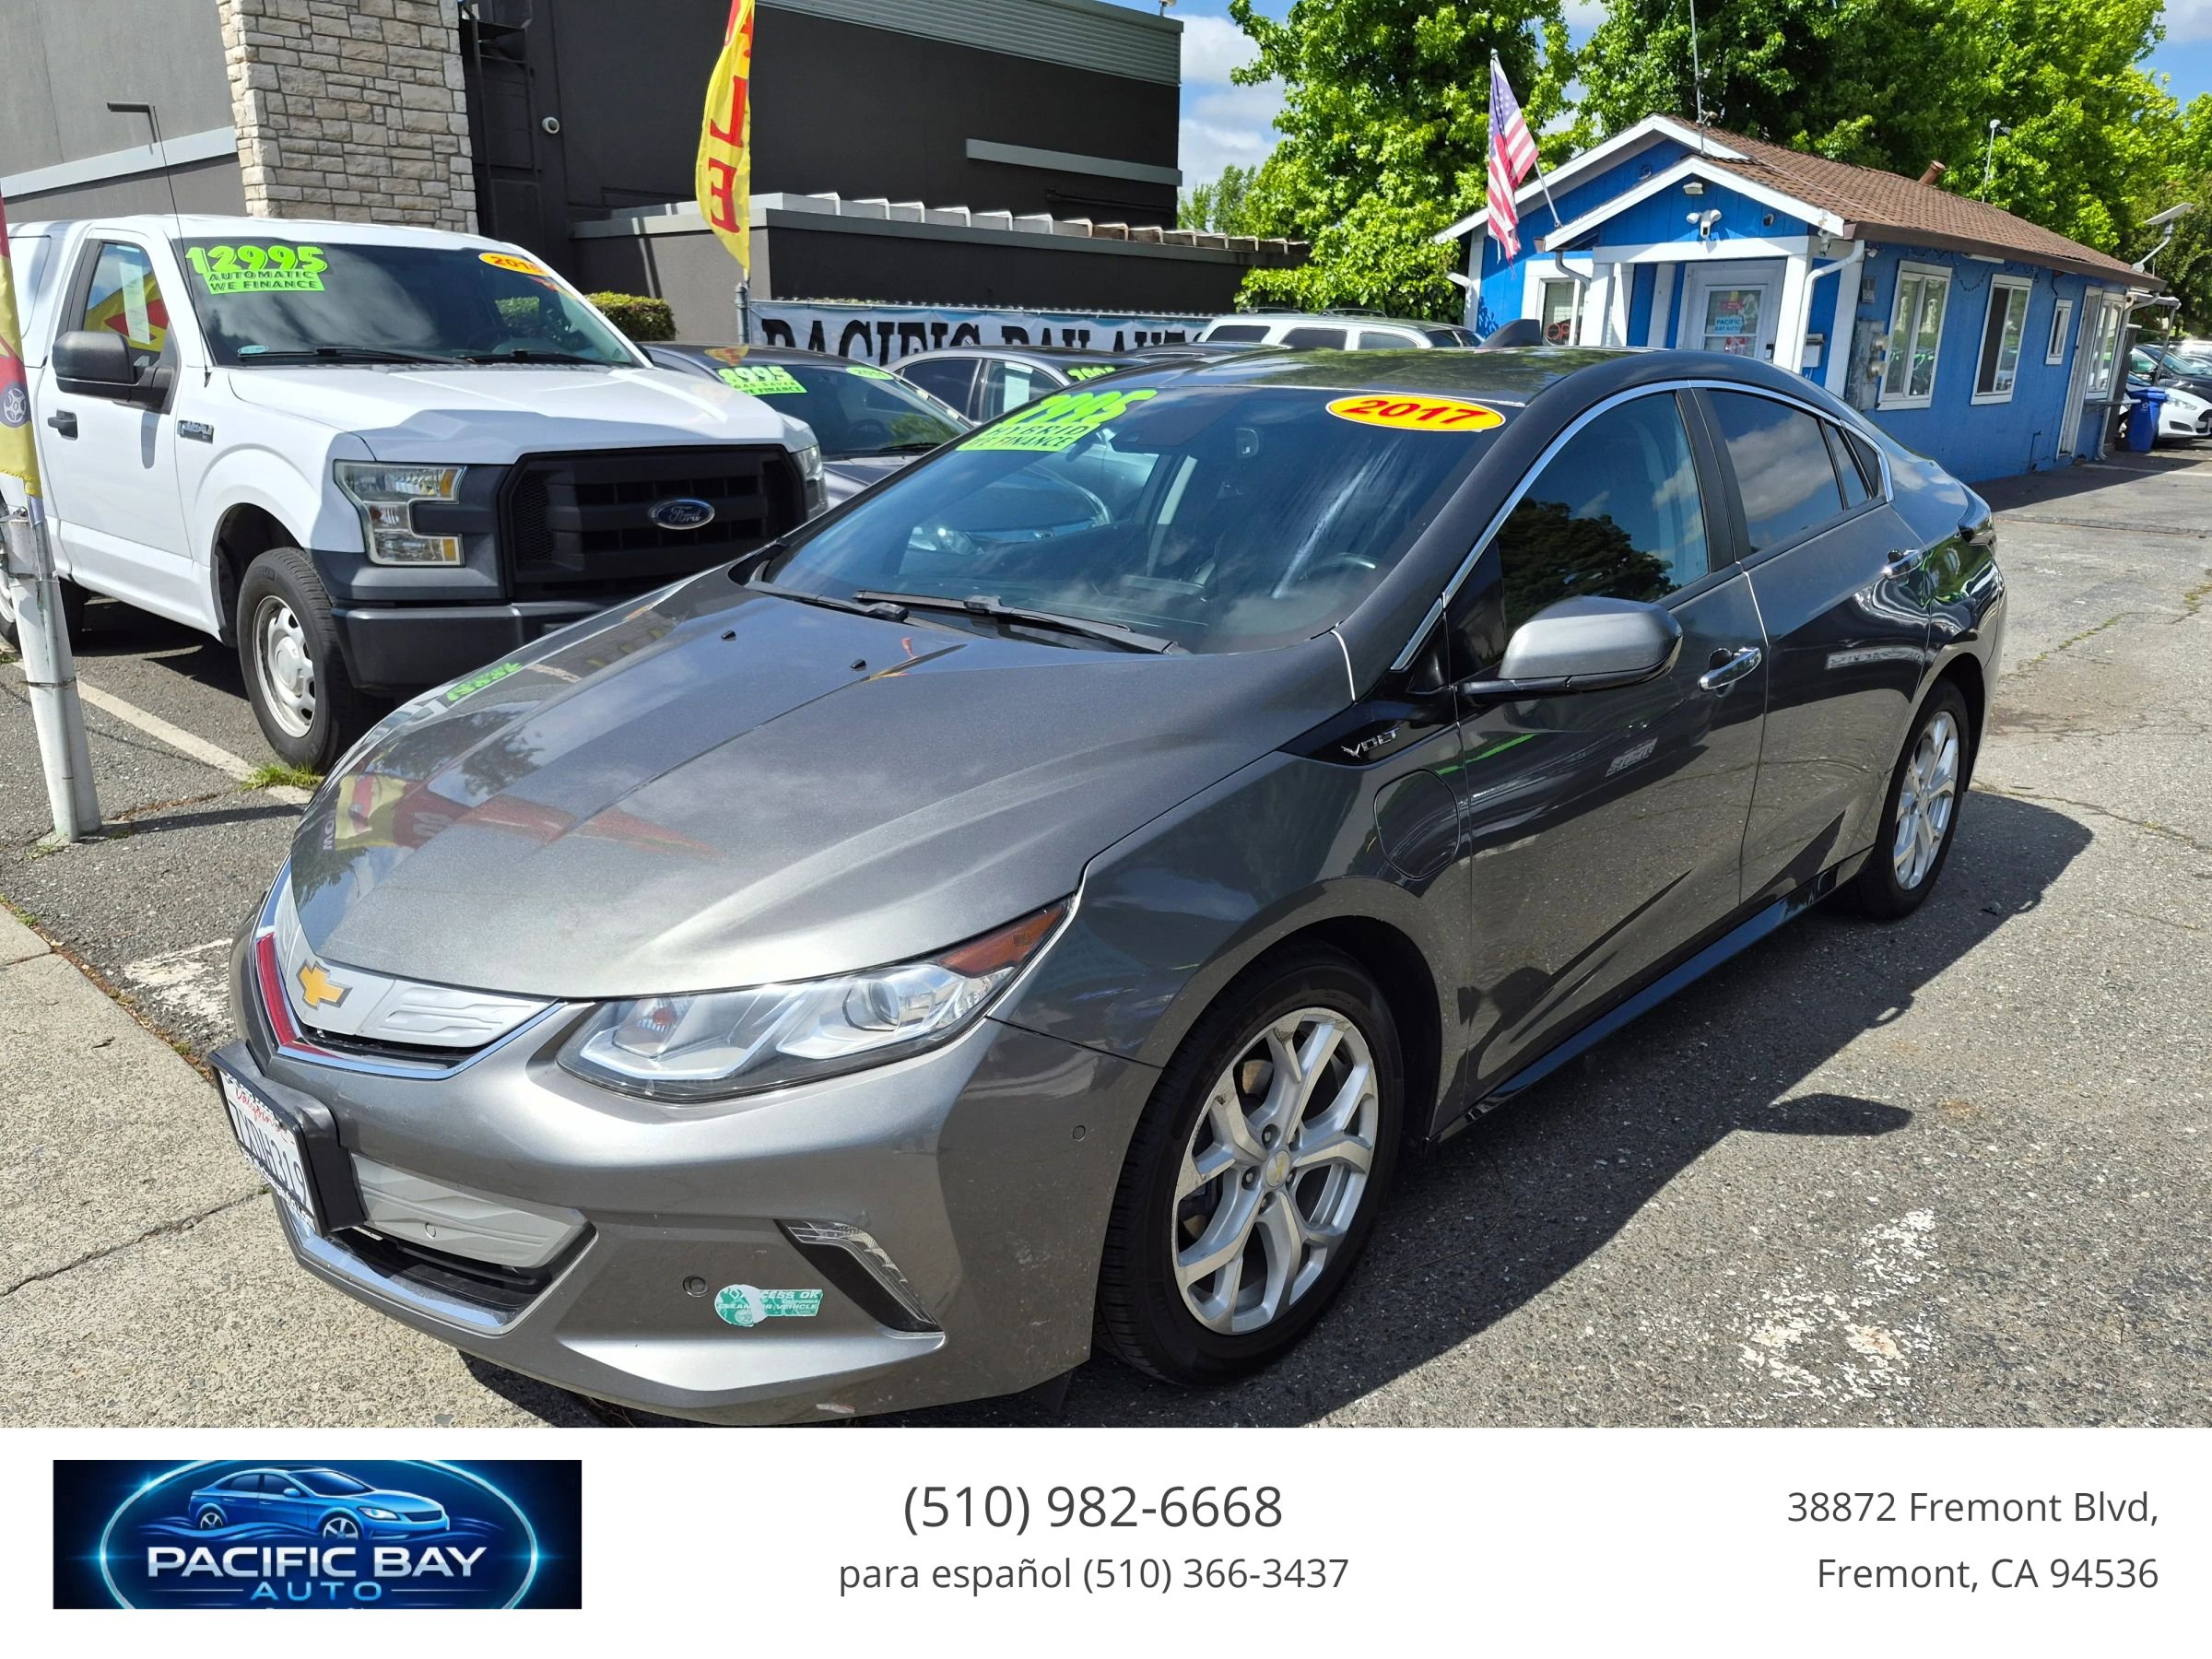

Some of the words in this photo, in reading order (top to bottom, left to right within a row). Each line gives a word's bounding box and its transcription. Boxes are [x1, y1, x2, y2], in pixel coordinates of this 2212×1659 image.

[185, 245, 327, 274] 12995
[208, 270, 314, 281] AUTOMATIC
[210, 282, 237, 291] WE
[243, 280, 318, 289] FINANCE
[1342, 399, 1488, 424] 2017
[984, 426, 1089, 435] HYBRID
[998, 436, 1072, 447] FINANCE
[1341, 726, 1400, 759] VOLT
[759, 1290, 795, 1299] CESS
[800, 1290, 819, 1299] OK
